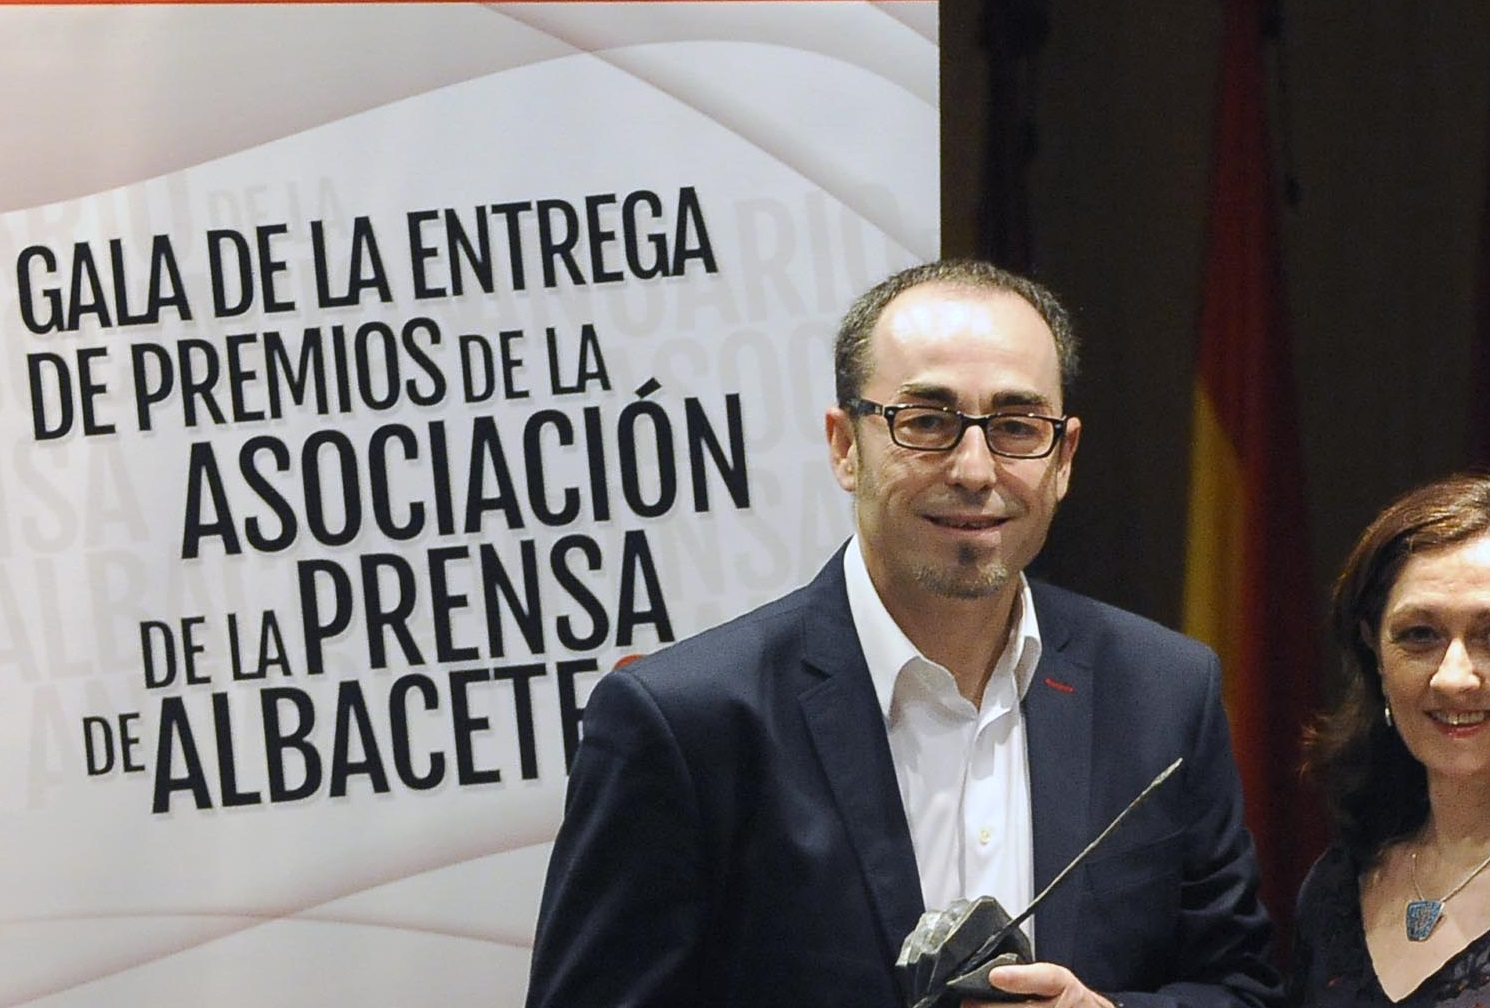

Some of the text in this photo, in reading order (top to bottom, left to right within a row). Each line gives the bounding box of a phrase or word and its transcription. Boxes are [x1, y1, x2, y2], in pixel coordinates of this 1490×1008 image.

[17, 187, 718, 334] GALA DE LA ENTREGA
[27, 318, 611, 440] DE PREMIOS DE LA
[182, 378, 750, 559] ASOCIACIÓN
[140, 530, 675, 689] DE LA PRENSA
[83, 713, 145, 775] DE
